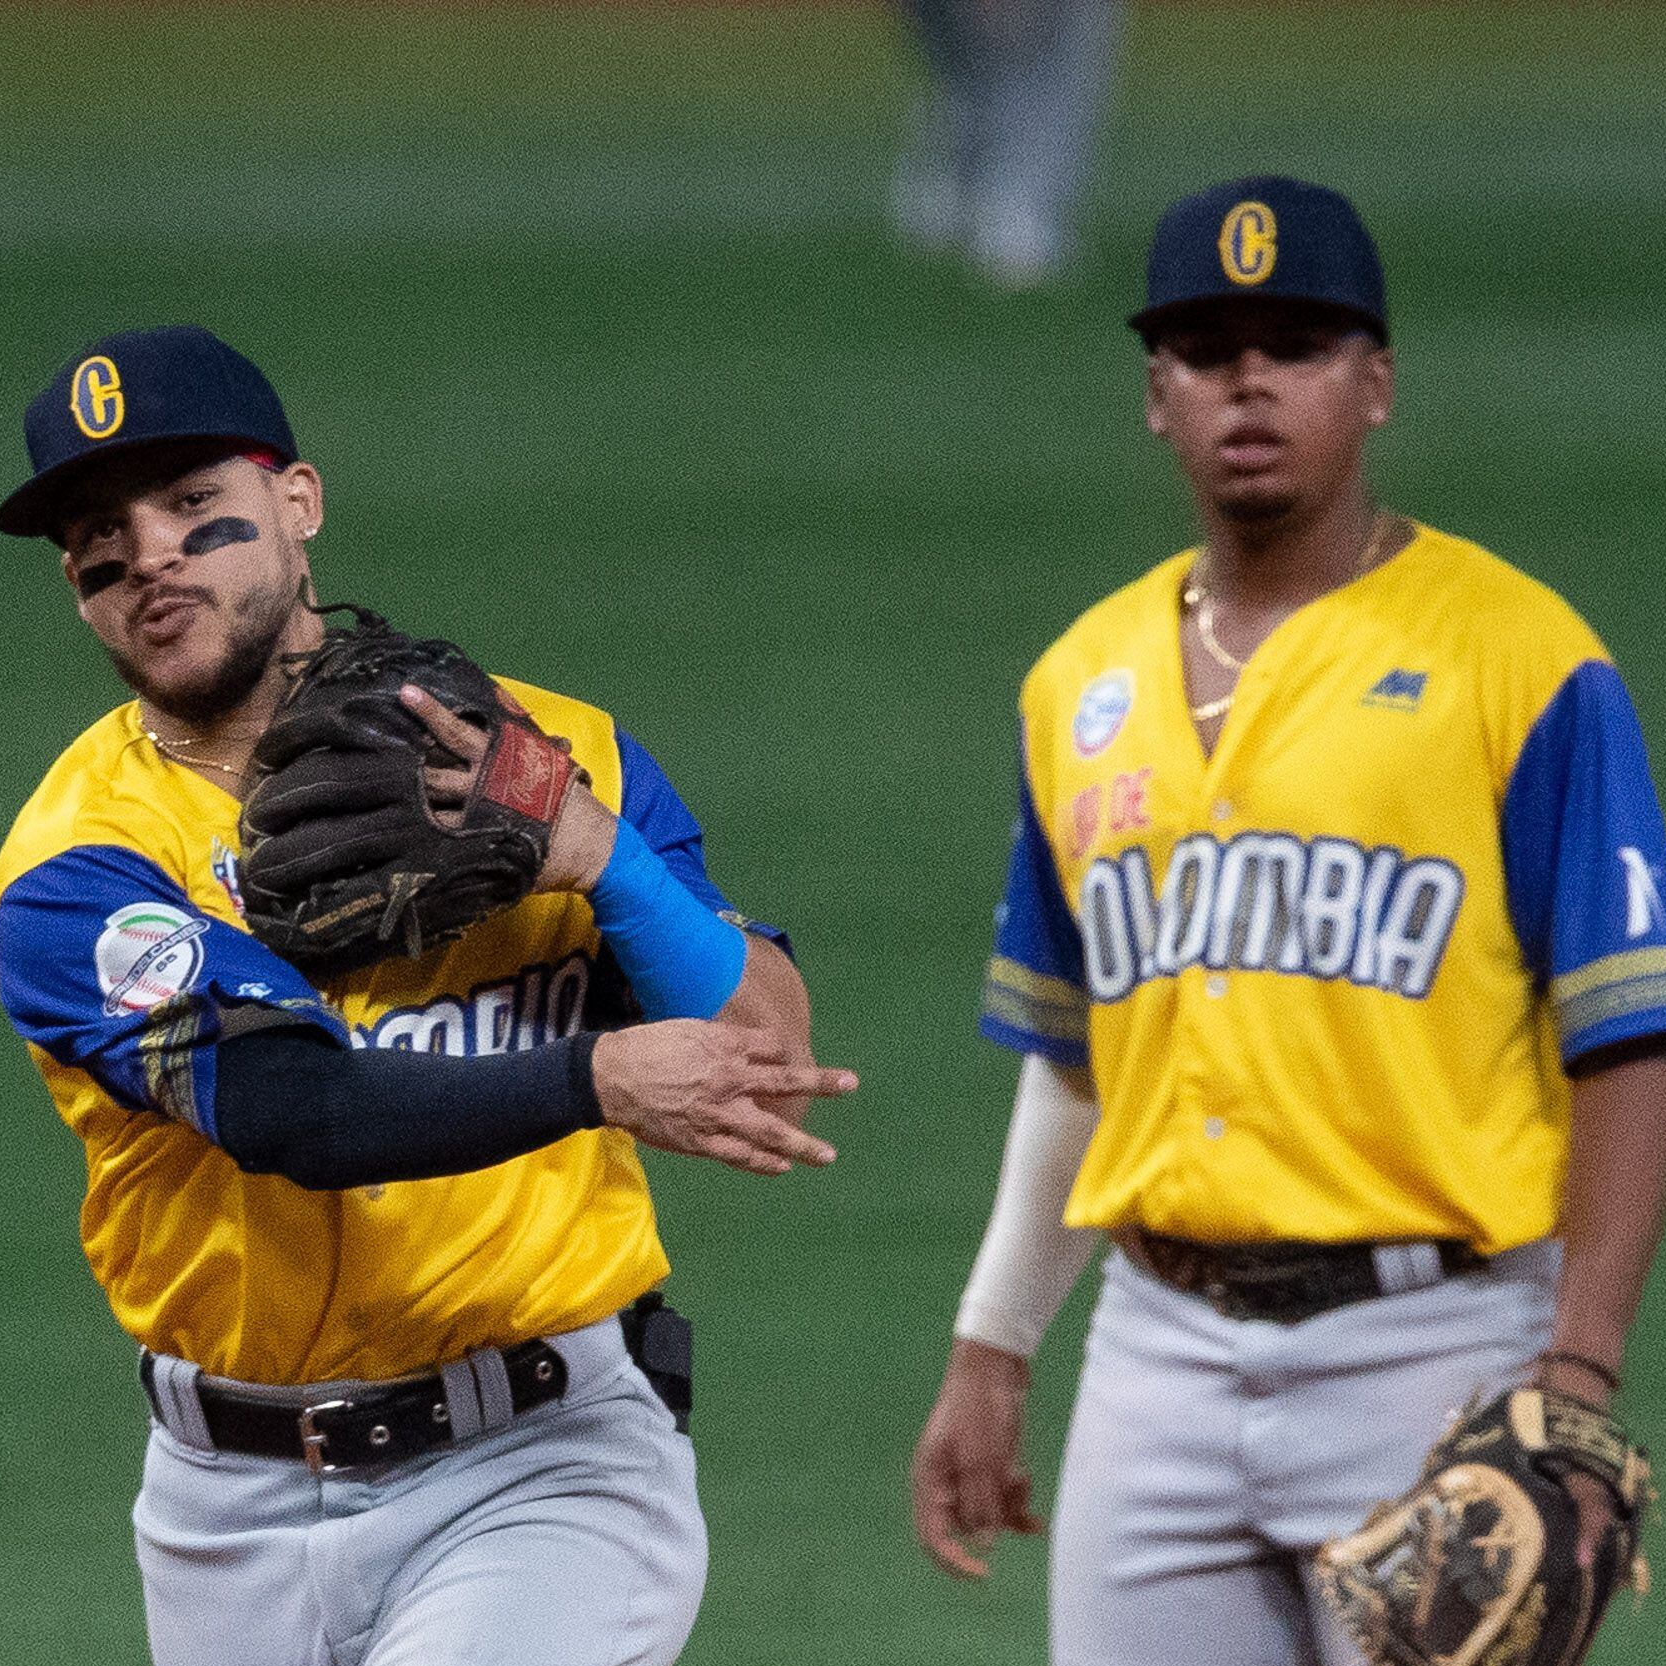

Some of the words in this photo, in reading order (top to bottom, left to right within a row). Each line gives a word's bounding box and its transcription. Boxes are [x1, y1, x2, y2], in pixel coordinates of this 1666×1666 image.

[1217, 202, 1278, 286] C
[71, 356, 125, 439] C
[1079, 830, 1466, 1004] OLOMBIA
